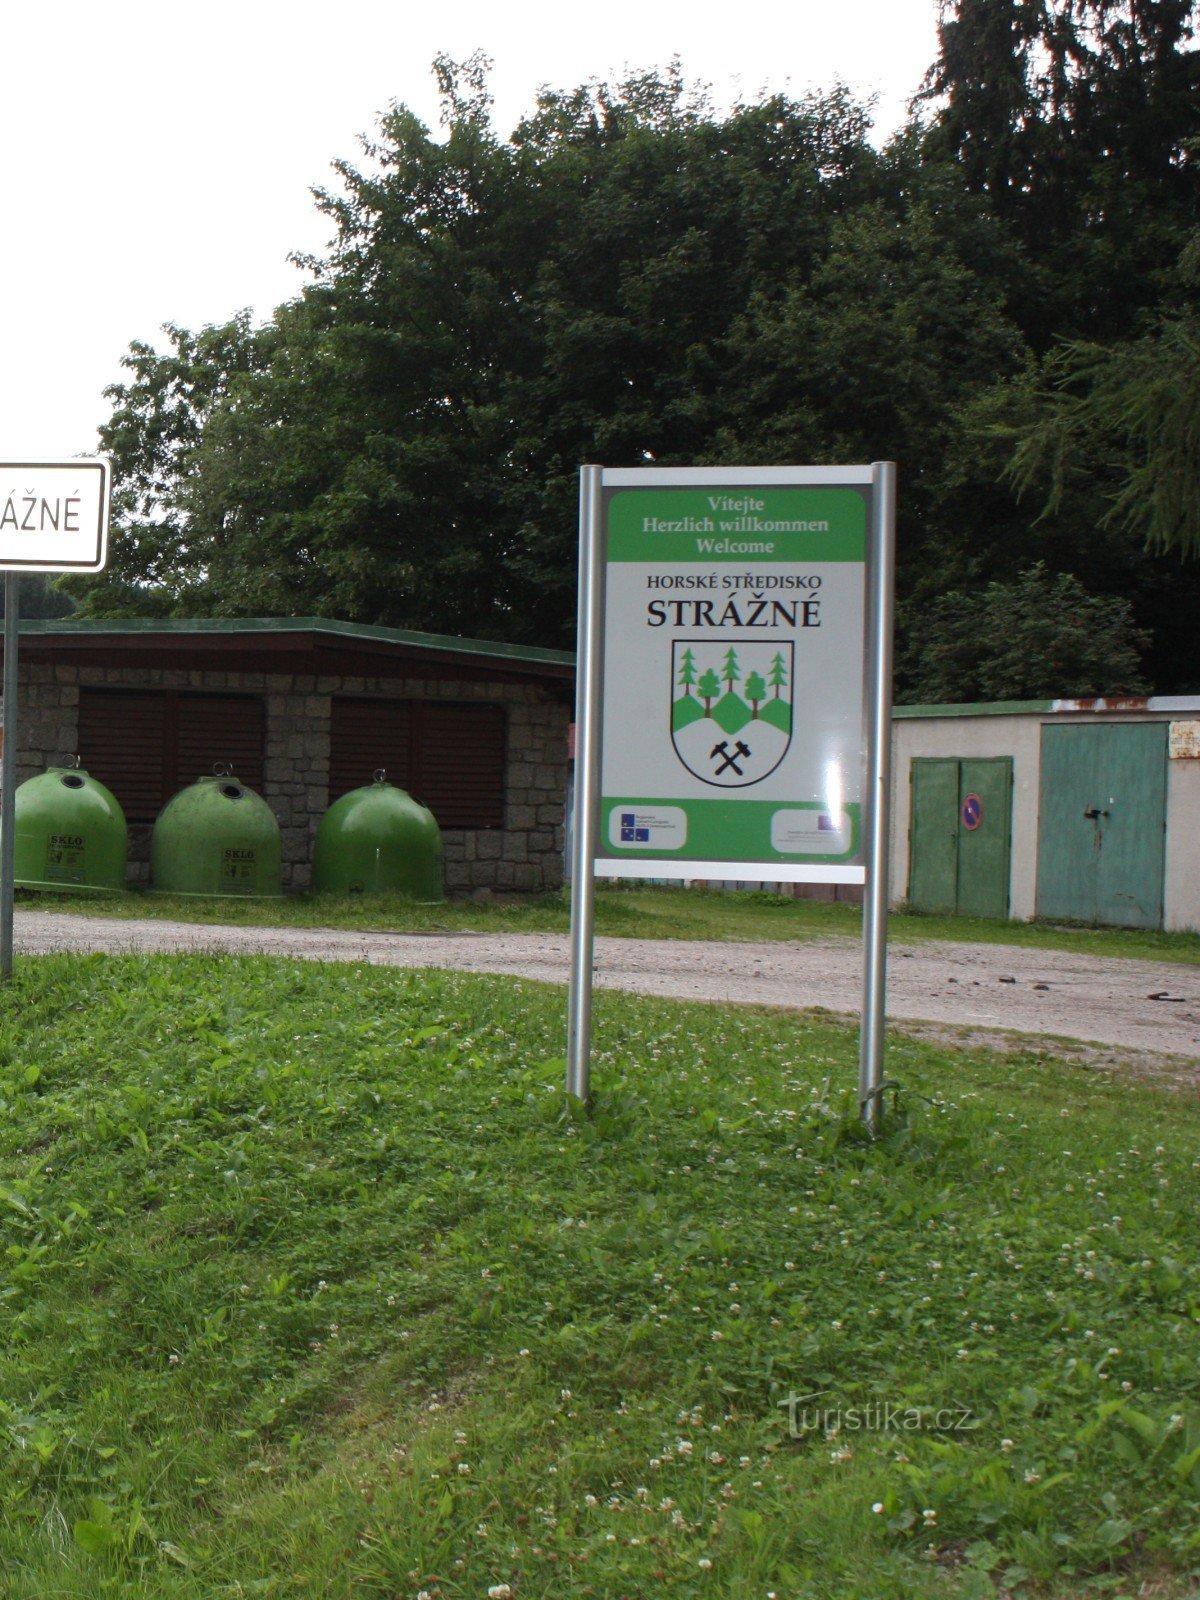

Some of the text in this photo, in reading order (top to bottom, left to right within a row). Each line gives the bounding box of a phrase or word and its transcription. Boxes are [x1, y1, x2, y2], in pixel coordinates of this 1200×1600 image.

[707, 496, 765, 515] Vítejte
[642, 516, 829, 533] Herzlich willkommen
[696, 538, 775, 554] Welcome
[646, 572, 823, 590] HORSKÉ STŘEDISKO
[647, 591, 822, 628] STRÁŽNÉ
[50, 835, 83, 846] SKLO
[224, 849, 255, 859] SKLO
